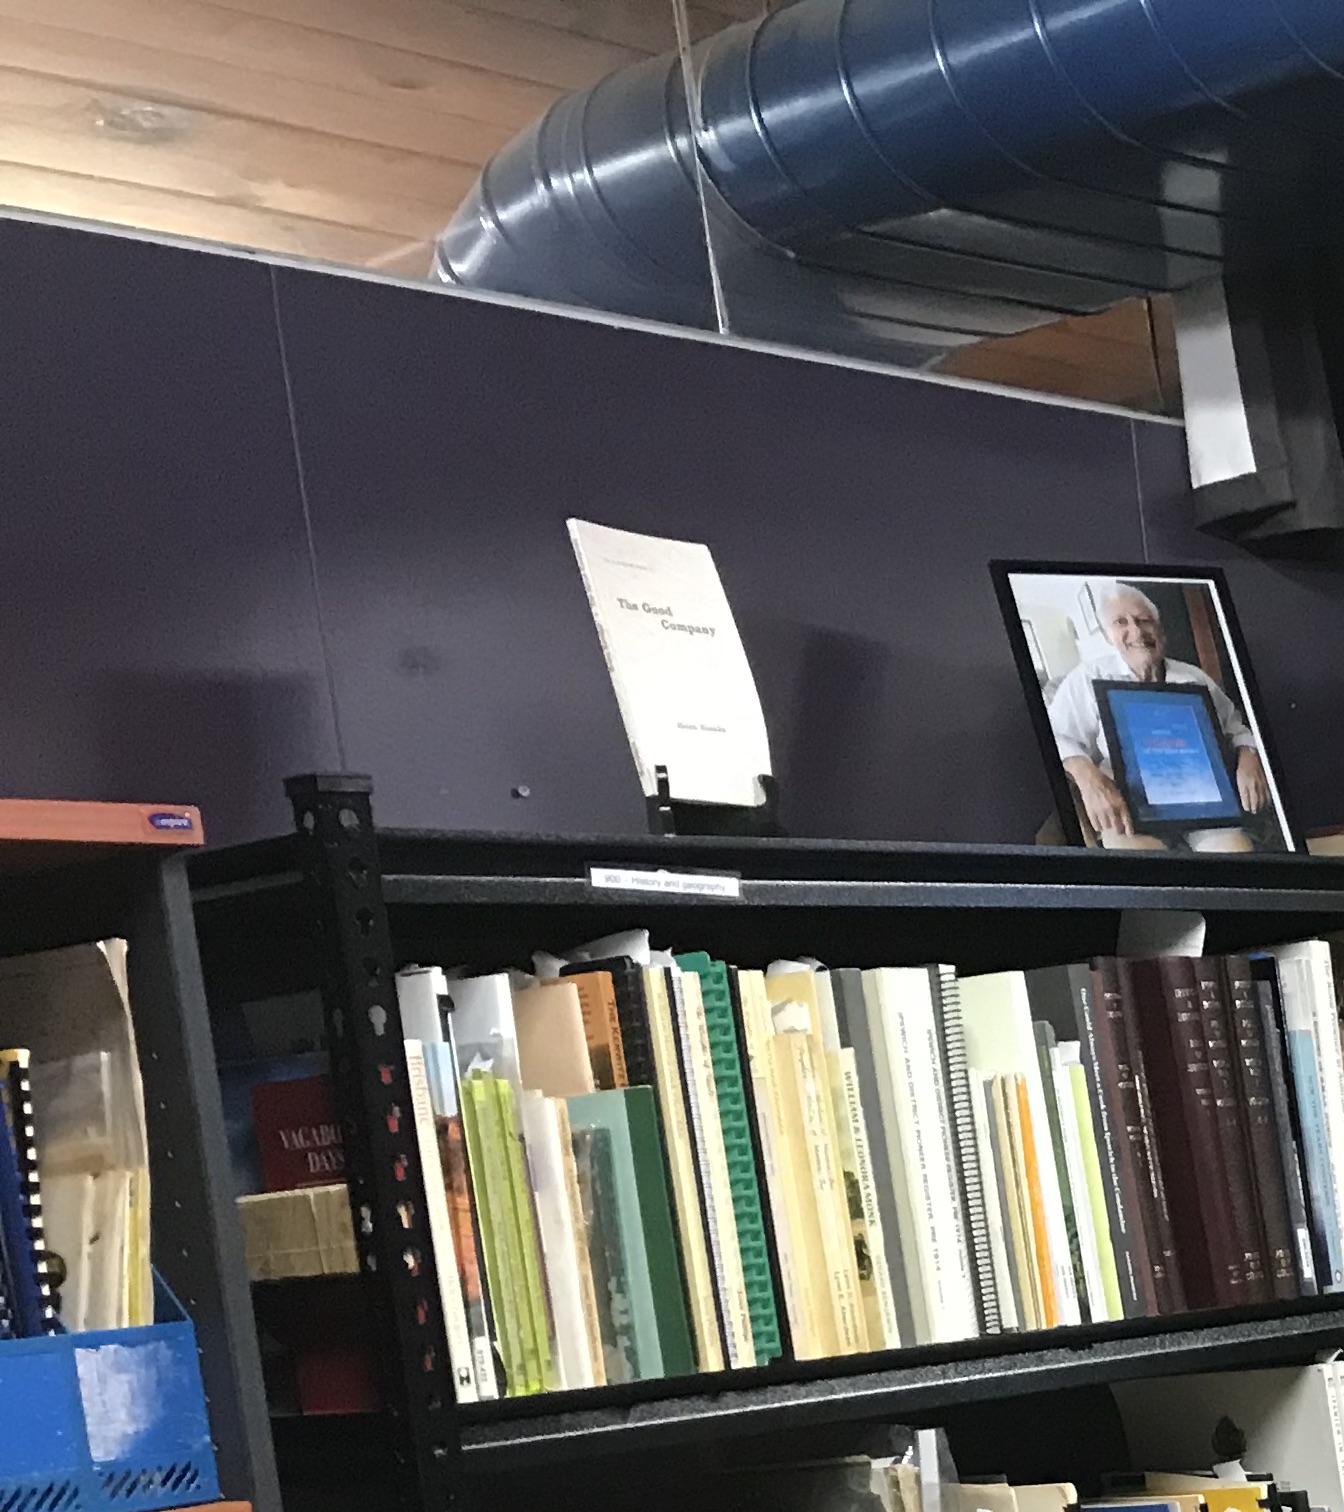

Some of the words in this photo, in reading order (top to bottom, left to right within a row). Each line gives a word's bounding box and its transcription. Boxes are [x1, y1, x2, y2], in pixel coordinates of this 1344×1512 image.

[617, 598, 638, 611] The
[642, 602, 673, 617] Good
[661, 619, 715, 638] Company
[631, 877, 661, 888] History
[664, 879, 679, 888] and
[682, 881, 725, 894] geography
[927, 1029, 936, 1064] IPSWICH
[845, 1071, 860, 1124] WILLIAM
[899, 1012, 909, 1053] IPSWICH
[904, 1057, 913, 1079] AND
[909, 1082, 920, 1125] DISTRICT
[915, 1130, 926, 1170] PIONEER
[279, 1124, 343, 1152] VAGABO
[1331, 1395, 1342, 1436] IPSWICH
